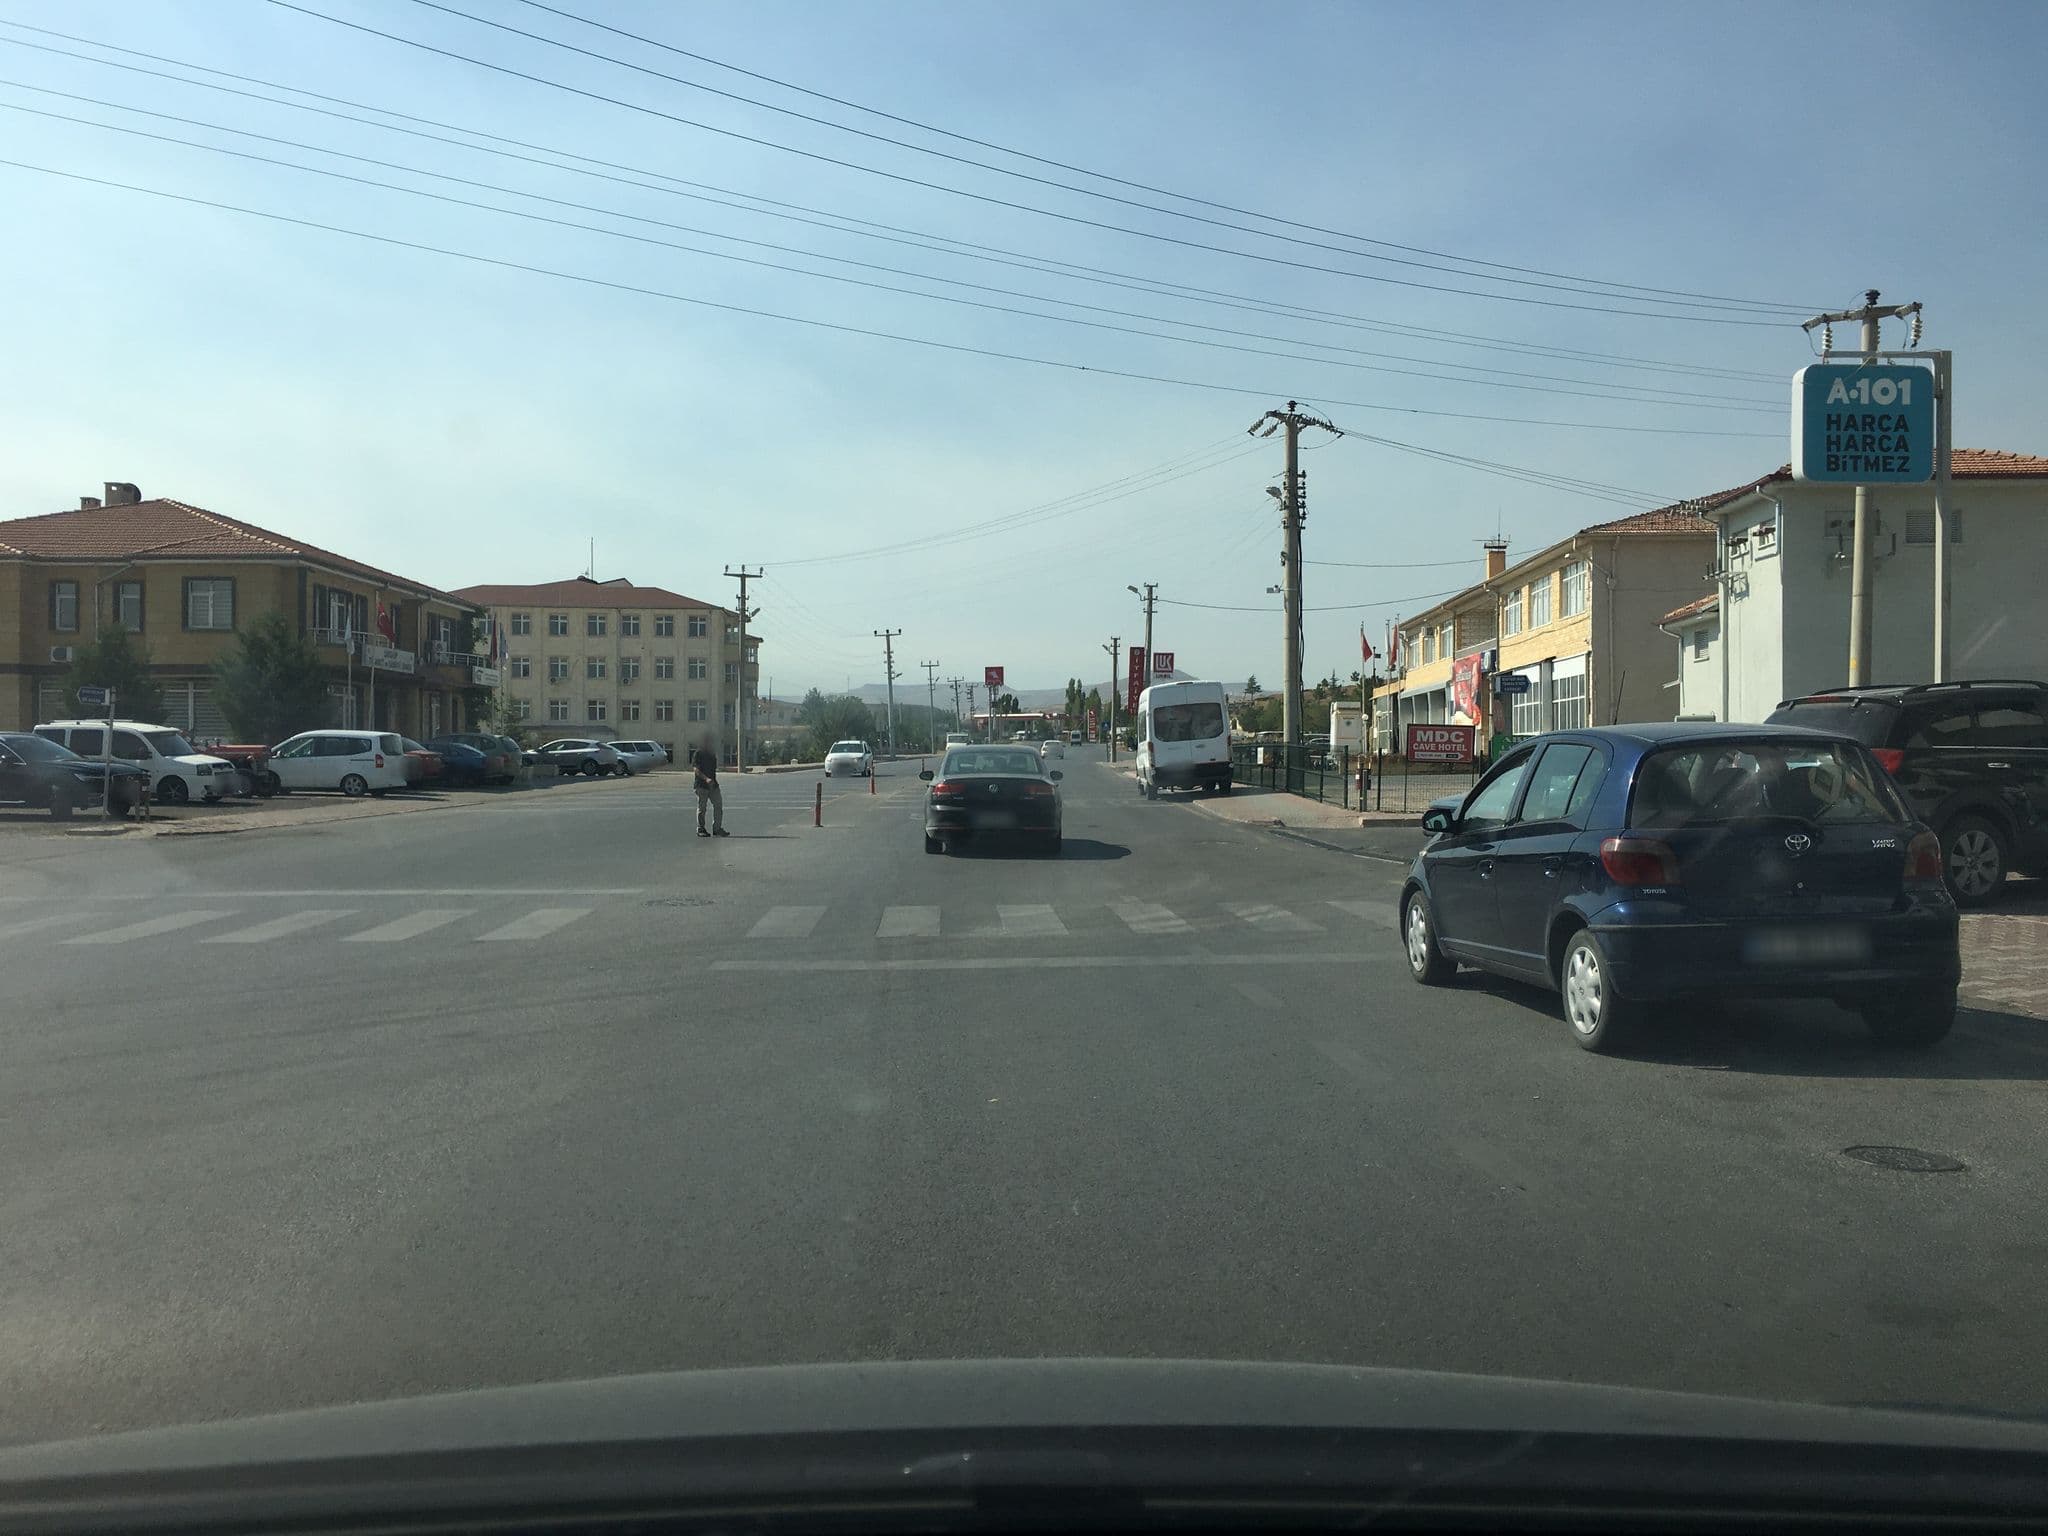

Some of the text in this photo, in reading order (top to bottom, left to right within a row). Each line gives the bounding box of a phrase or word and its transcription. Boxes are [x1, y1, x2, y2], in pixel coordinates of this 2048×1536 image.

[1826, 413, 1910, 432] HARCA
[1826, 434, 1910, 453] HARCA
[1416, 730, 1465, 744] MDC
[1412, 743, 1468, 752] CAVE HOTEL
